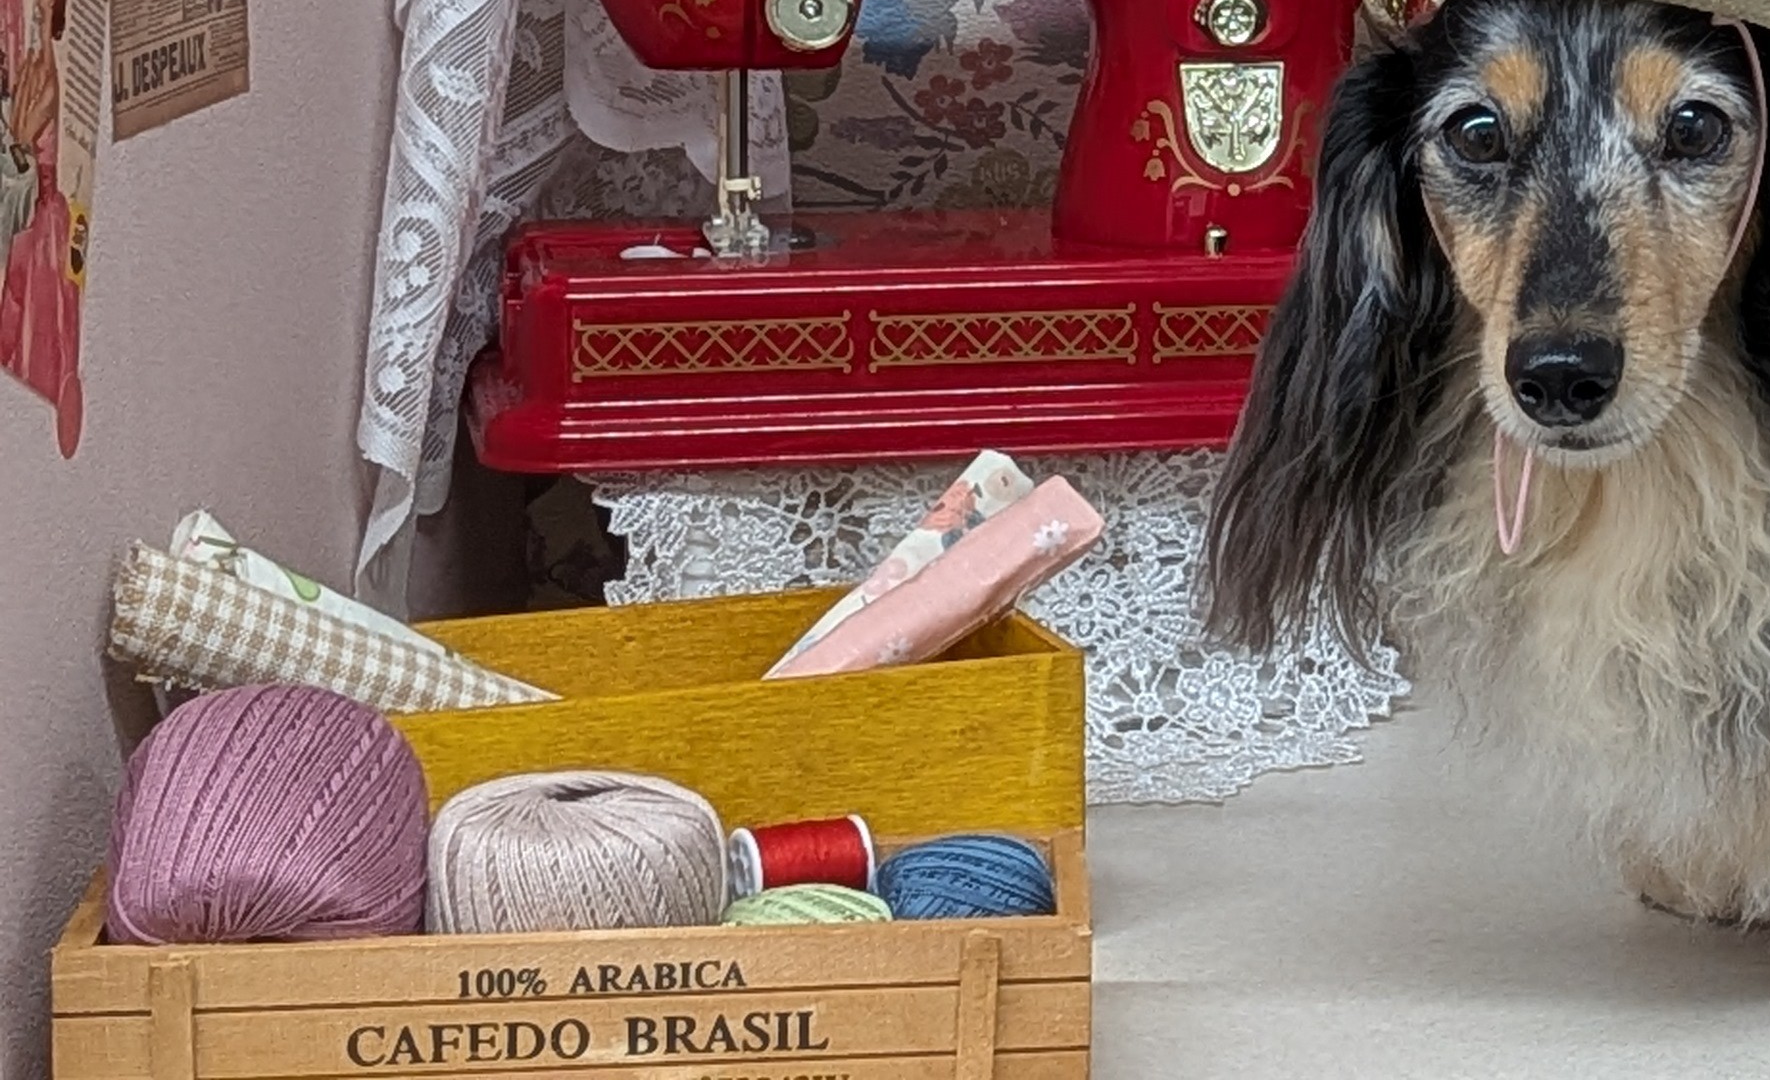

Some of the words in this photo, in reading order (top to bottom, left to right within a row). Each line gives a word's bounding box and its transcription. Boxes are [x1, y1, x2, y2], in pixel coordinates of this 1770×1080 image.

[132, 31, 206, 97] DESPEAUX
[457, 967, 548, 998] 100%
[569, 960, 748, 995] ARABICA
[346, 1020, 591, 1067] CAFEDO
[625, 1012, 829, 1058] BRASIL
